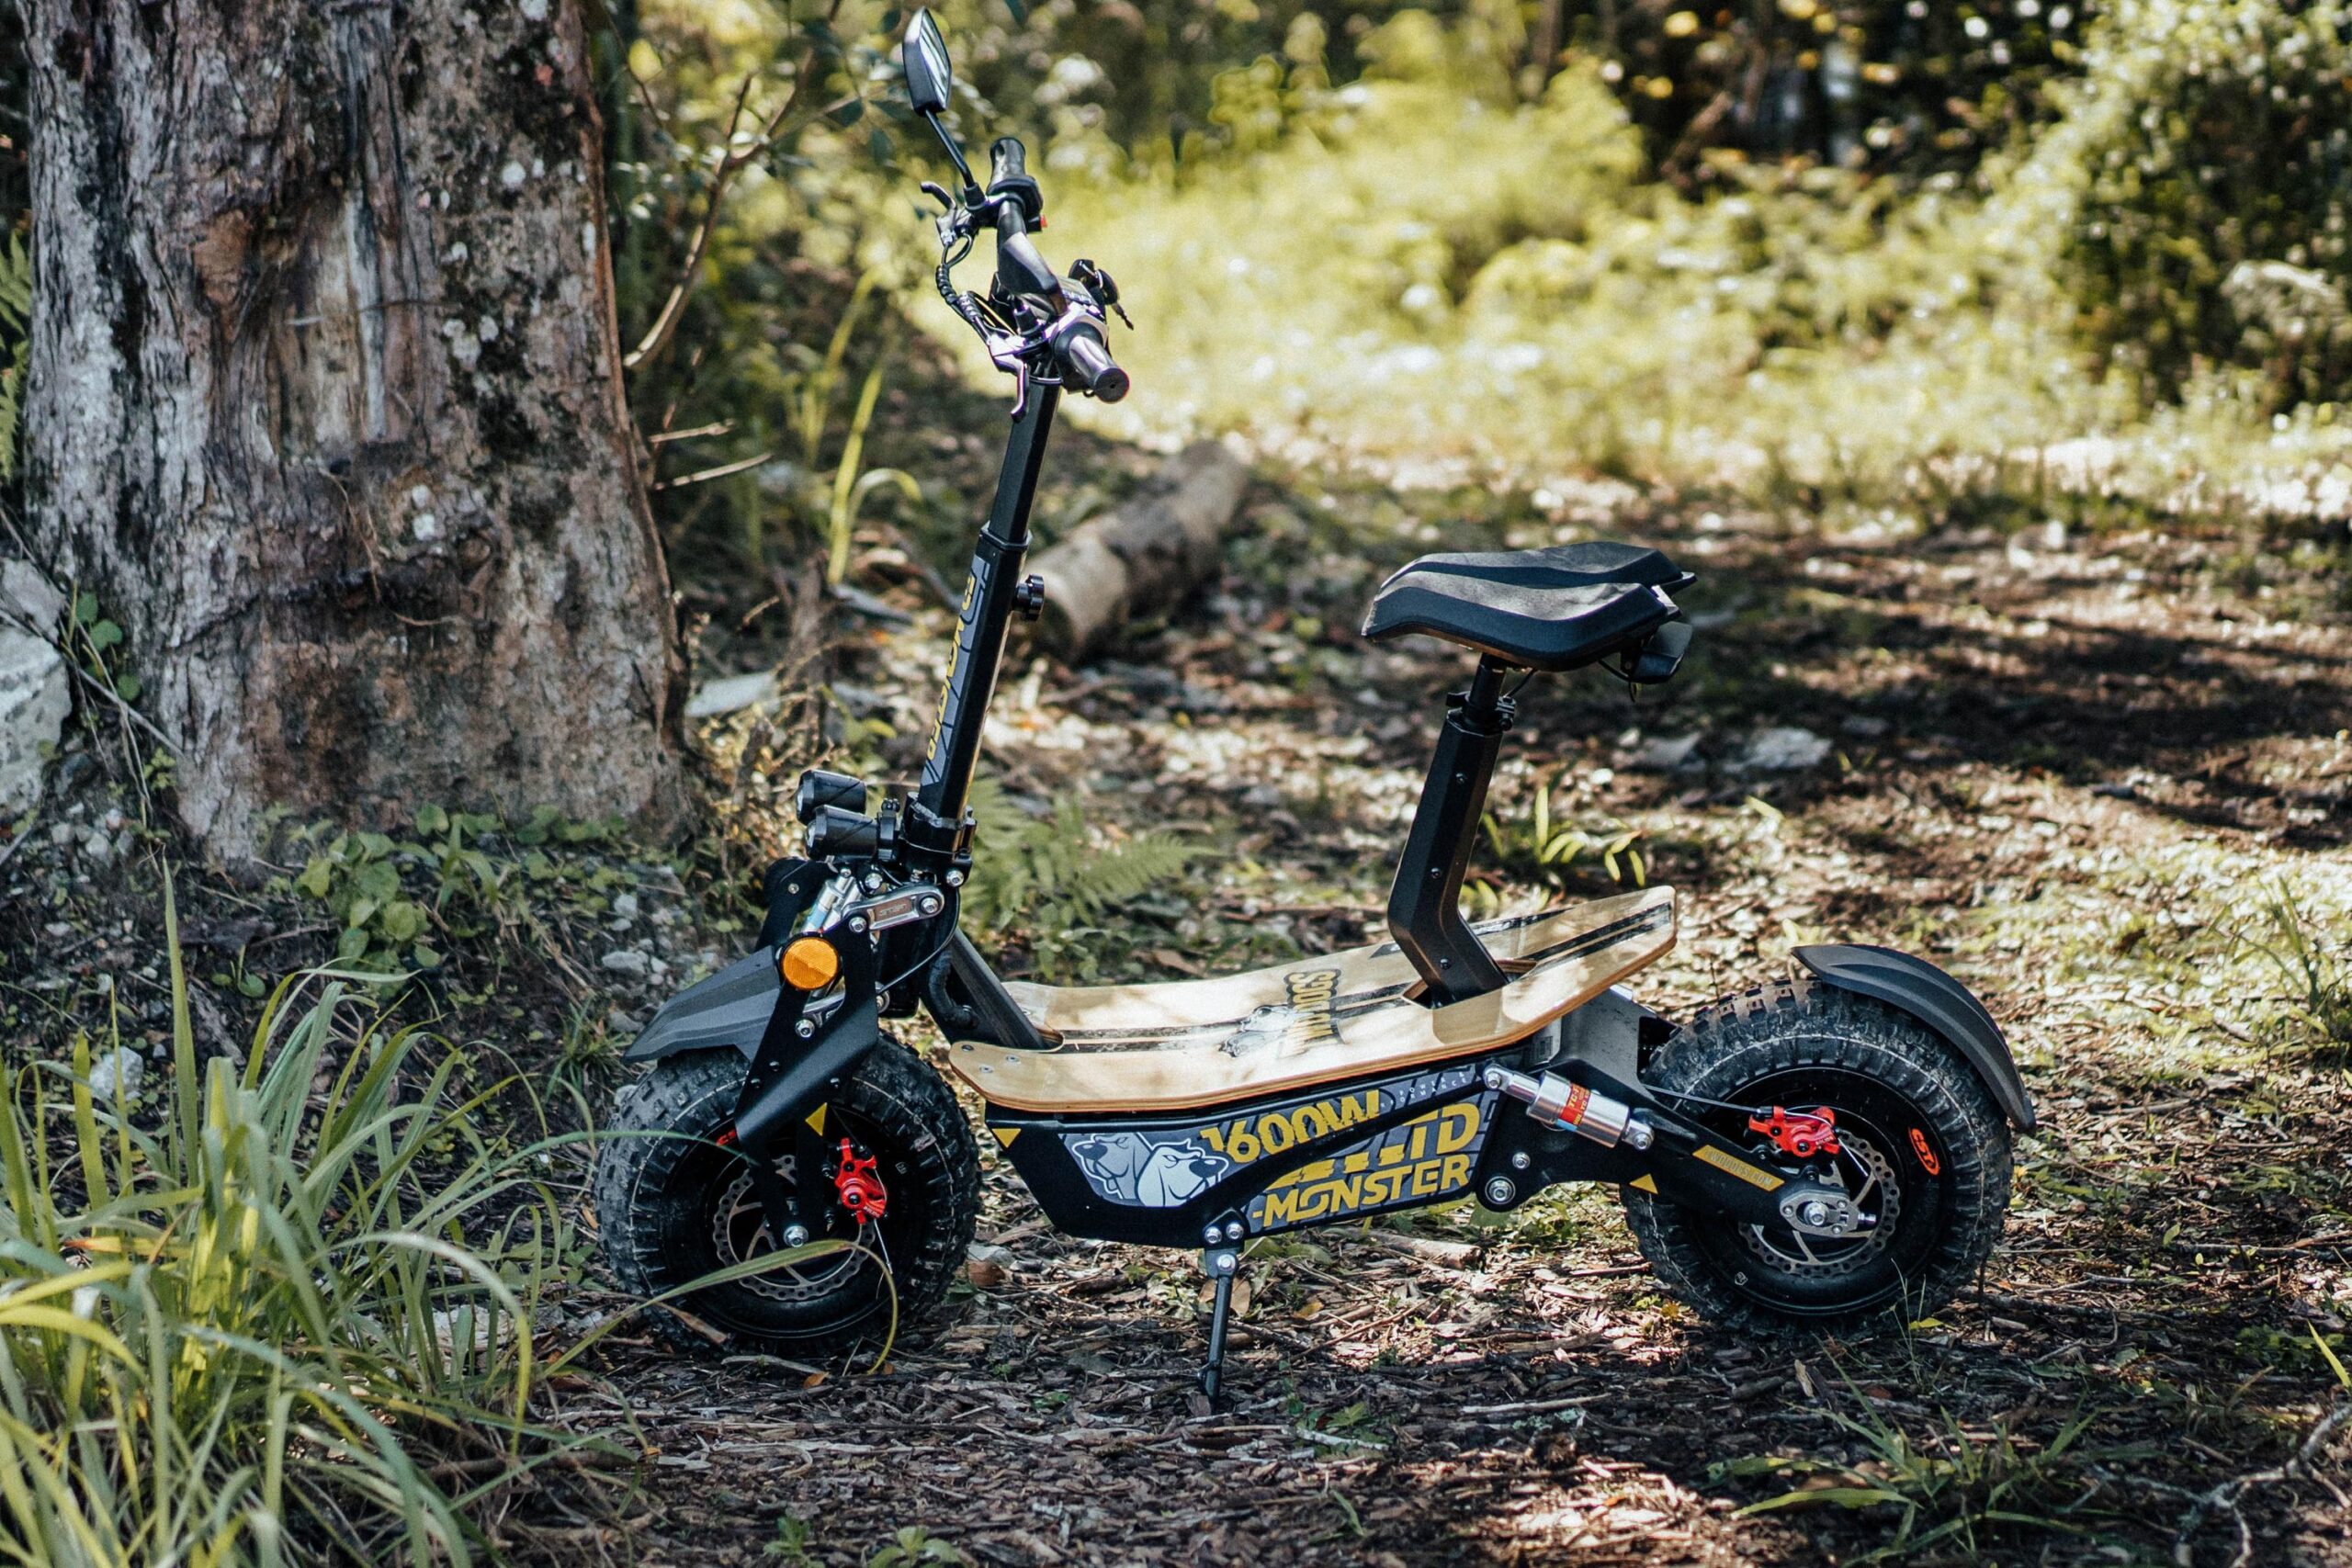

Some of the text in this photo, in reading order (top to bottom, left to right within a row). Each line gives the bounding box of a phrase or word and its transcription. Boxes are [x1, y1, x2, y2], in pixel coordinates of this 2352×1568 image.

[1288, 971, 1338, 1013] DOGS
[1398, 1076, 1447, 1097] POWER
[1200, 1089, 1380, 1164] 1600W
[1262, 1154, 1471, 1228] MONSTER
